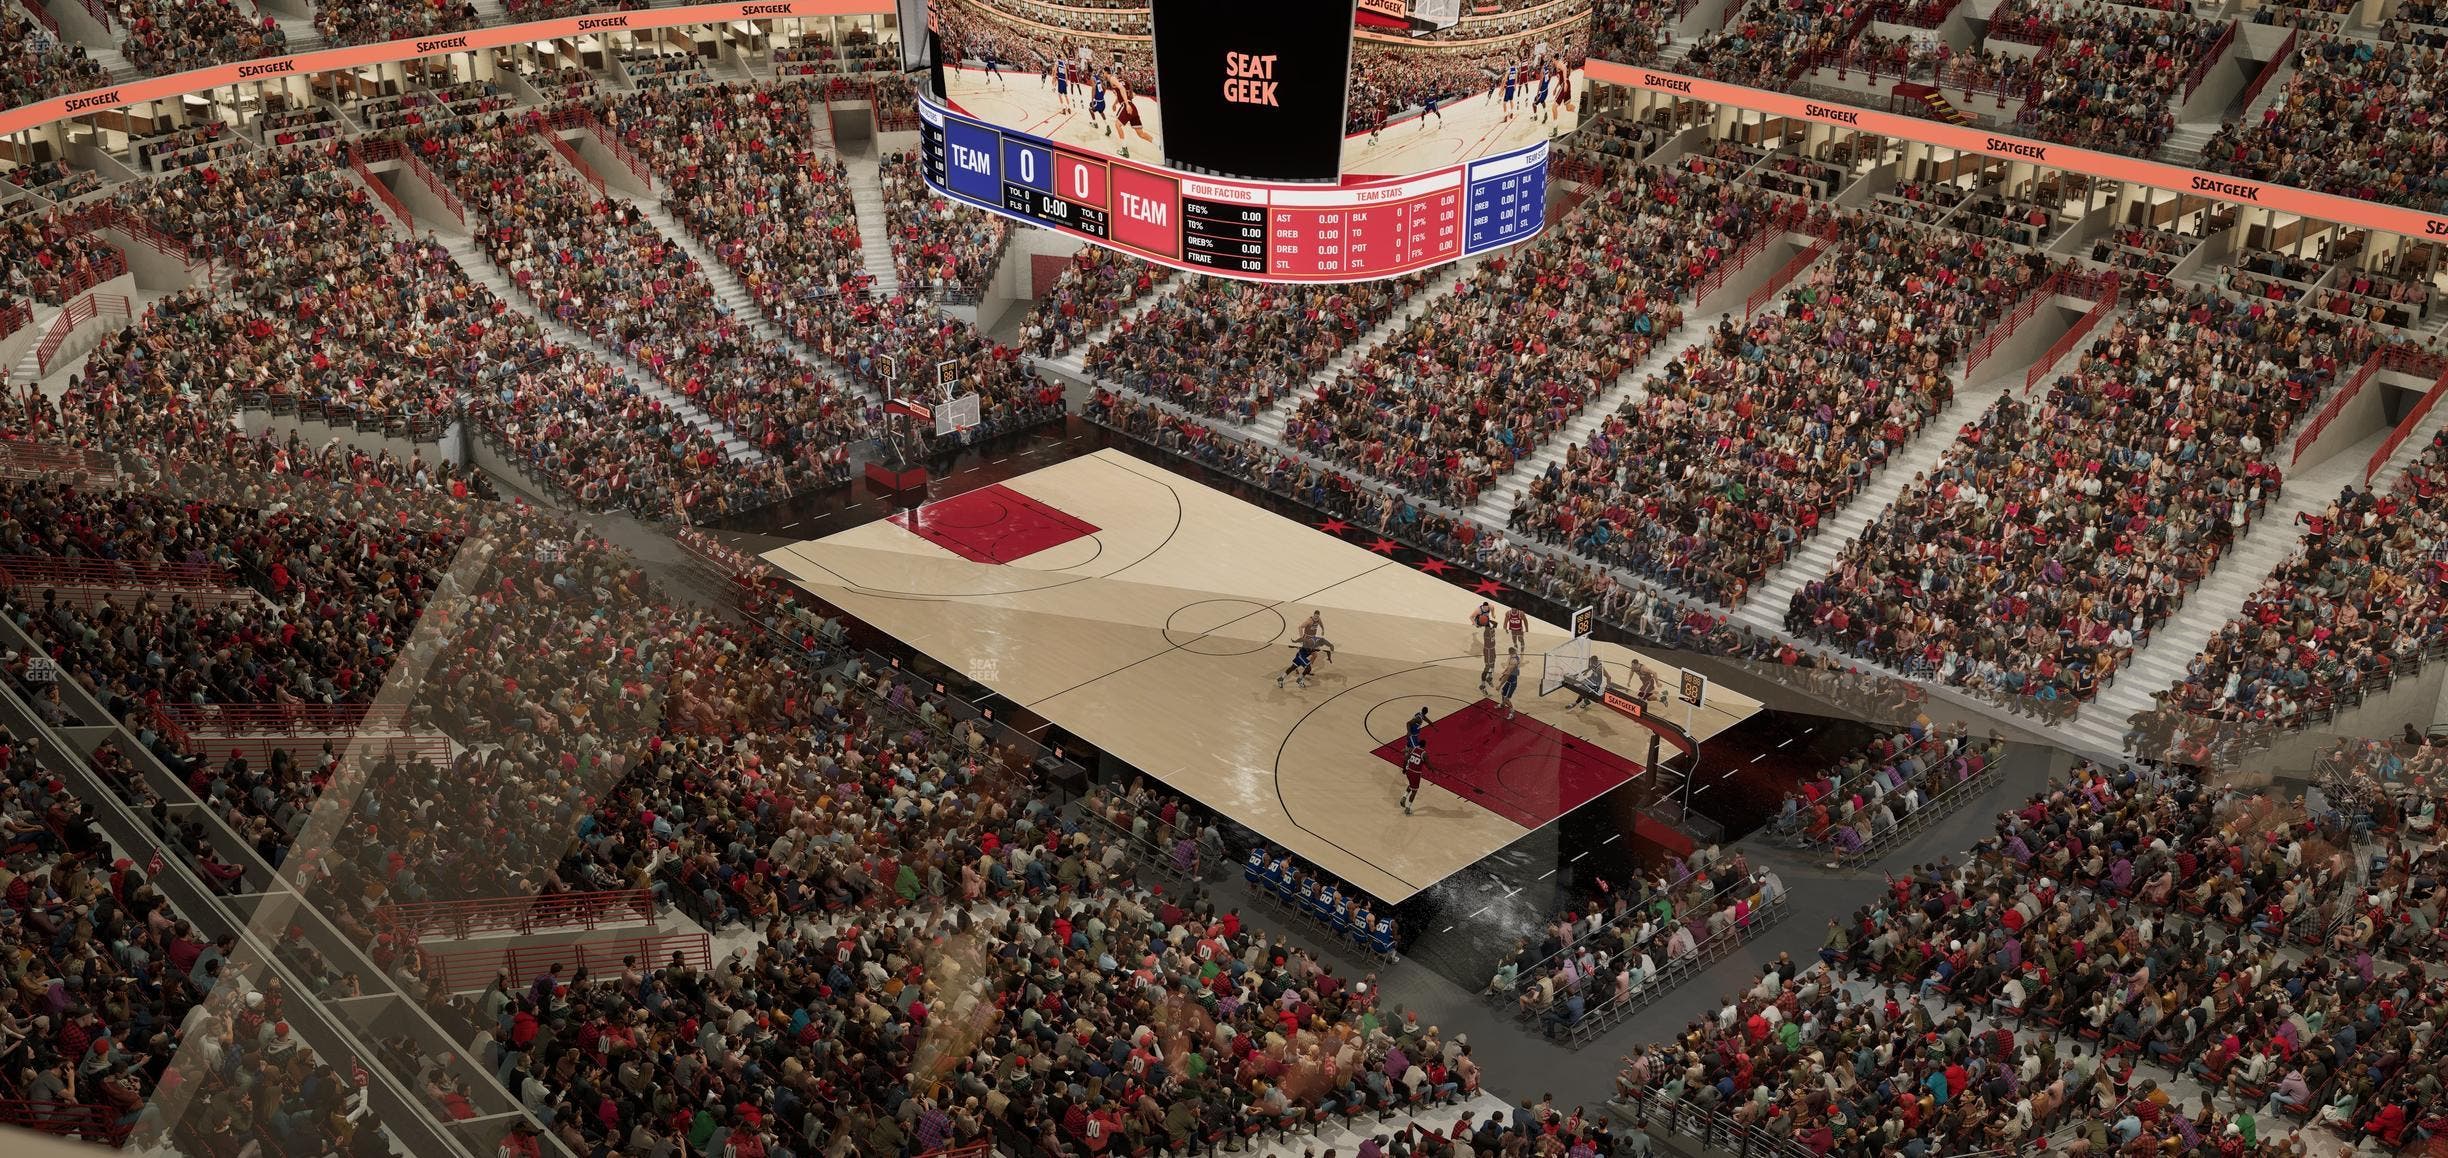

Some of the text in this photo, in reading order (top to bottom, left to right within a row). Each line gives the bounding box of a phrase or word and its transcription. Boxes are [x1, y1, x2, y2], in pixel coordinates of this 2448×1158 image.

[742, 4, 791, 15] SEATGEEK
[579, 16, 627, 30] SEATGEEK
[417, 36, 467, 52] SEATGEEK
[239, 60, 294, 77] SEATGEEK
[1226, 51, 1277, 79] SEAT
[1645, 74, 1691, 93] SEATGEEK
[1223, 78, 1279, 107] GEEK
[65, 91, 120, 112] SEATGEEK
[1806, 105, 1857, 124] SEATGEEK
[1987, 138, 2045, 160] SEATGEEK
[951, 143, 991, 176] TEAM
[1020, 149, 1034, 183] 0
[1074, 164, 1089, 199] 0
[1475, 179, 1515, 197] AST 0.00
[2192, 177, 2259, 201] SEATGEEK
[1009, 187, 1030, 200] TOL 0
[1191, 184, 1252, 200] FOUR FACTORS
[1356, 187, 1403, 202] TEAM STATS
[1010, 200, 1030, 213] FLS 0
[1043, 197, 1067, 218] 0:00
[1413, 195, 1455, 213] 2P% 0.00
[1501, 194, 1515, 206] 0.00
[1081, 208, 1103, 222] TOL 0
[1120, 191, 1167, 227] TEAM
[1241, 211, 1261, 222] 0.00
[1352, 207, 1402, 222] BLK 0
[1440, 210, 1454, 221] 0.00
[1500, 208, 1514, 220] 0.00
[1276, 214, 1339, 224] AST 0.00
[1082, 222, 1103, 236] FLS 0
[1241, 228, 1261, 238] 0.00
[1318, 229, 1339, 239] 0.00
[1396, 223, 1402, 232] 0
[1439, 225, 1454, 237] 0.00
[1499, 223, 1513, 235] 0.00
[1241, 244, 1261, 255] 0.00
[1318, 245, 1338, 255] 0.00
[1395, 238, 1401, 247] 0
[1439, 240, 1453, 252] 0.00
[1188, 252, 1261, 271] FTRATE 0.00
[1276, 260, 1338, 270] STL 0.00
[1351, 253, 1401, 268] STL 0
[1248, 855, 1262, 866] 00
[1376, 922, 1389, 933] 00
[1200, 944, 1212, 960] 00
[1131, 1055, 1145, 1074] 00
[1086, 1119, 1100, 1138] 00
